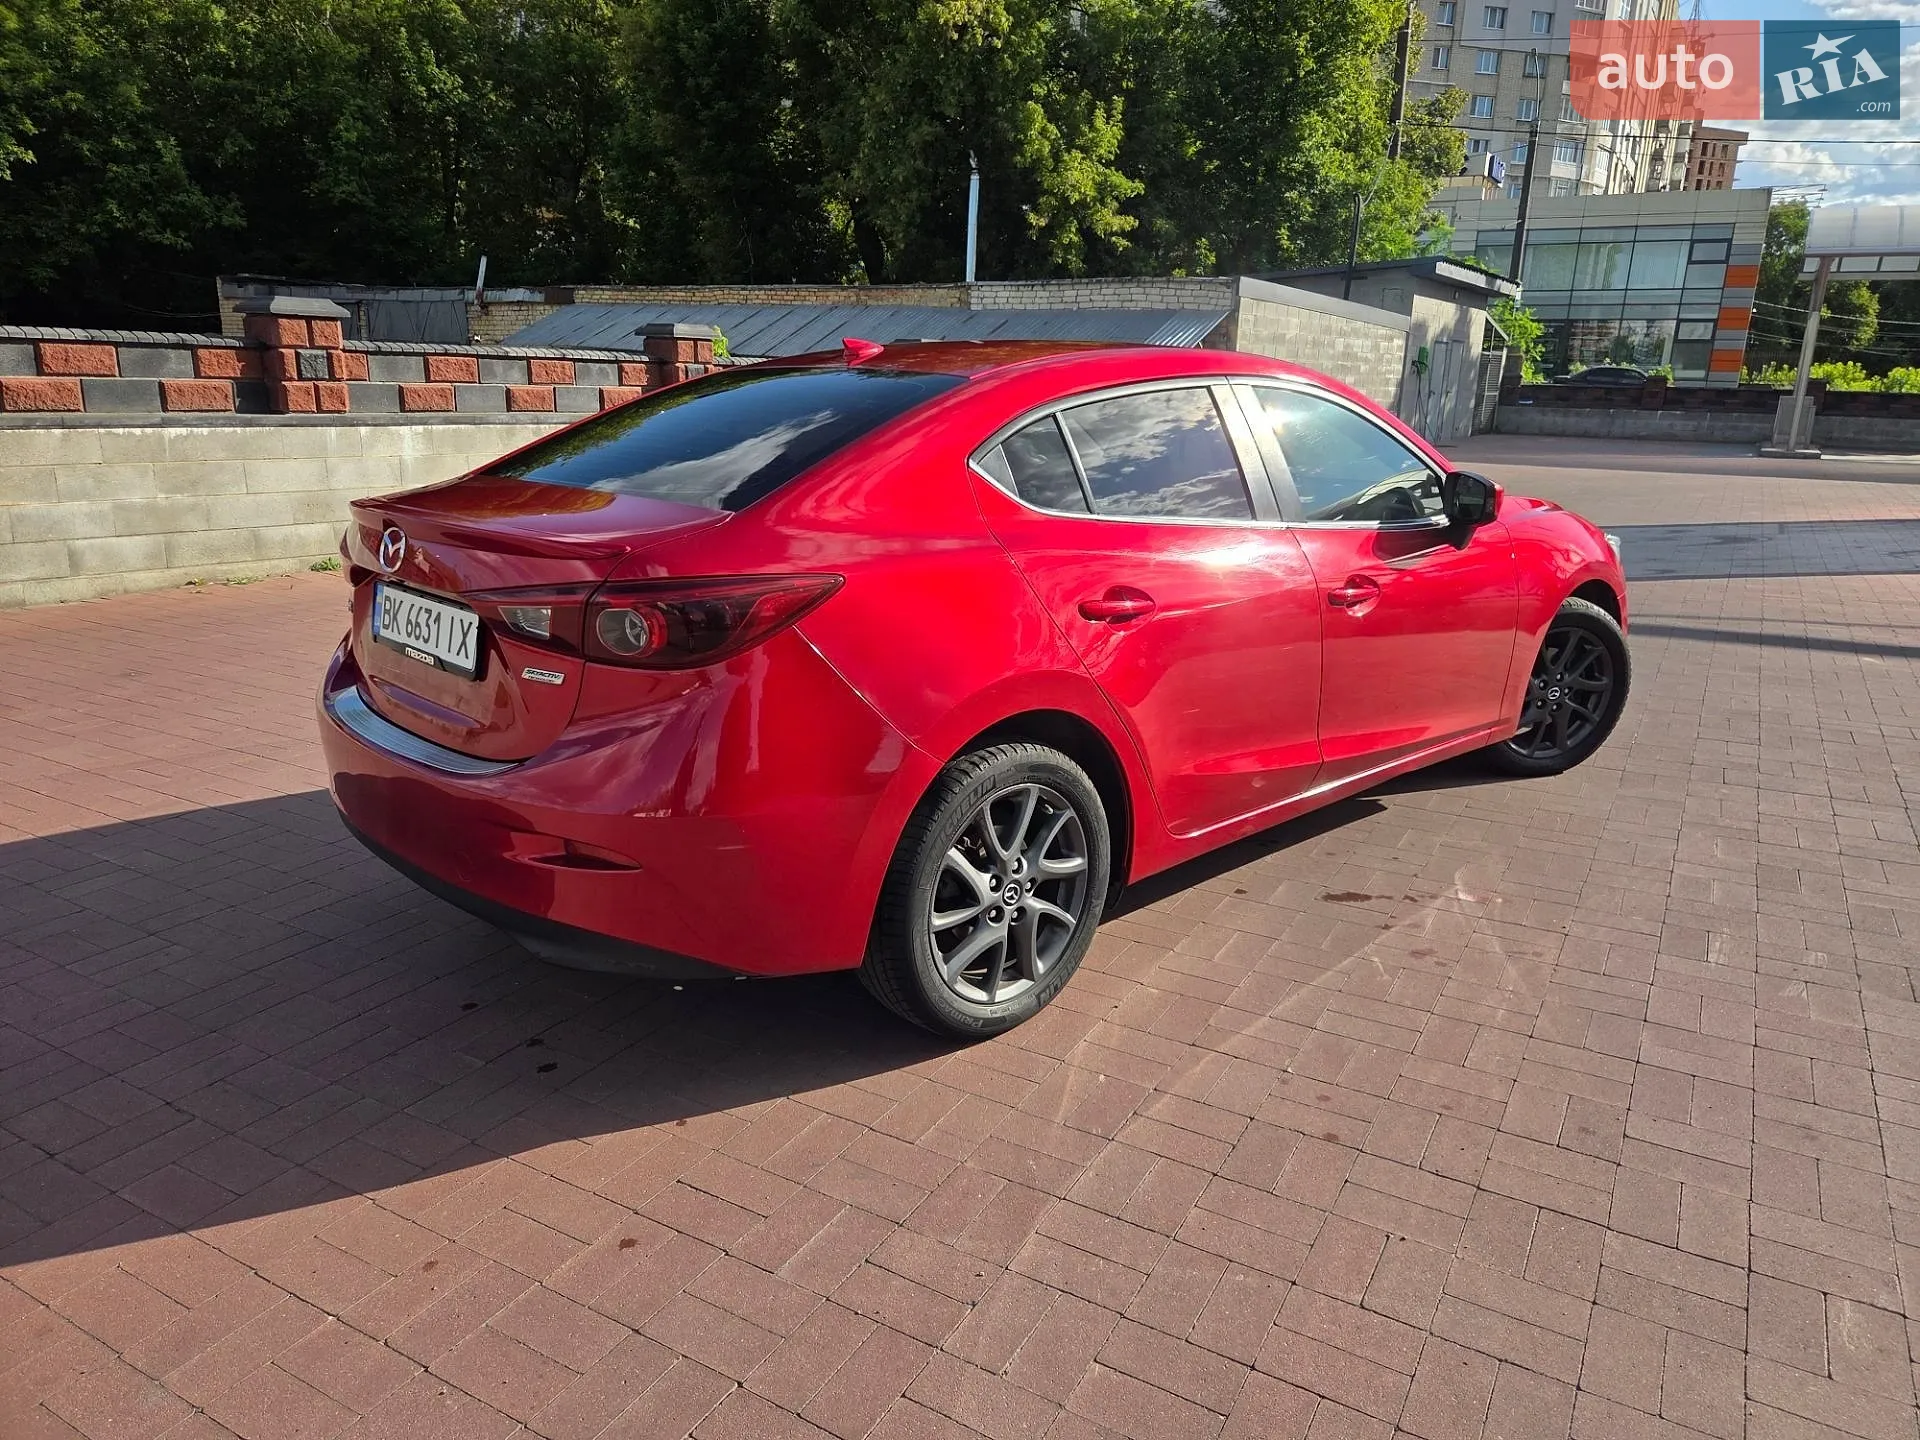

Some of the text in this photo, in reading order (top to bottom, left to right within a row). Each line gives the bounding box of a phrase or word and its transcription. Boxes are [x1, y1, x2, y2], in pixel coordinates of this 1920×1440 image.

[382, 595, 474, 660] BK 6631 IX
